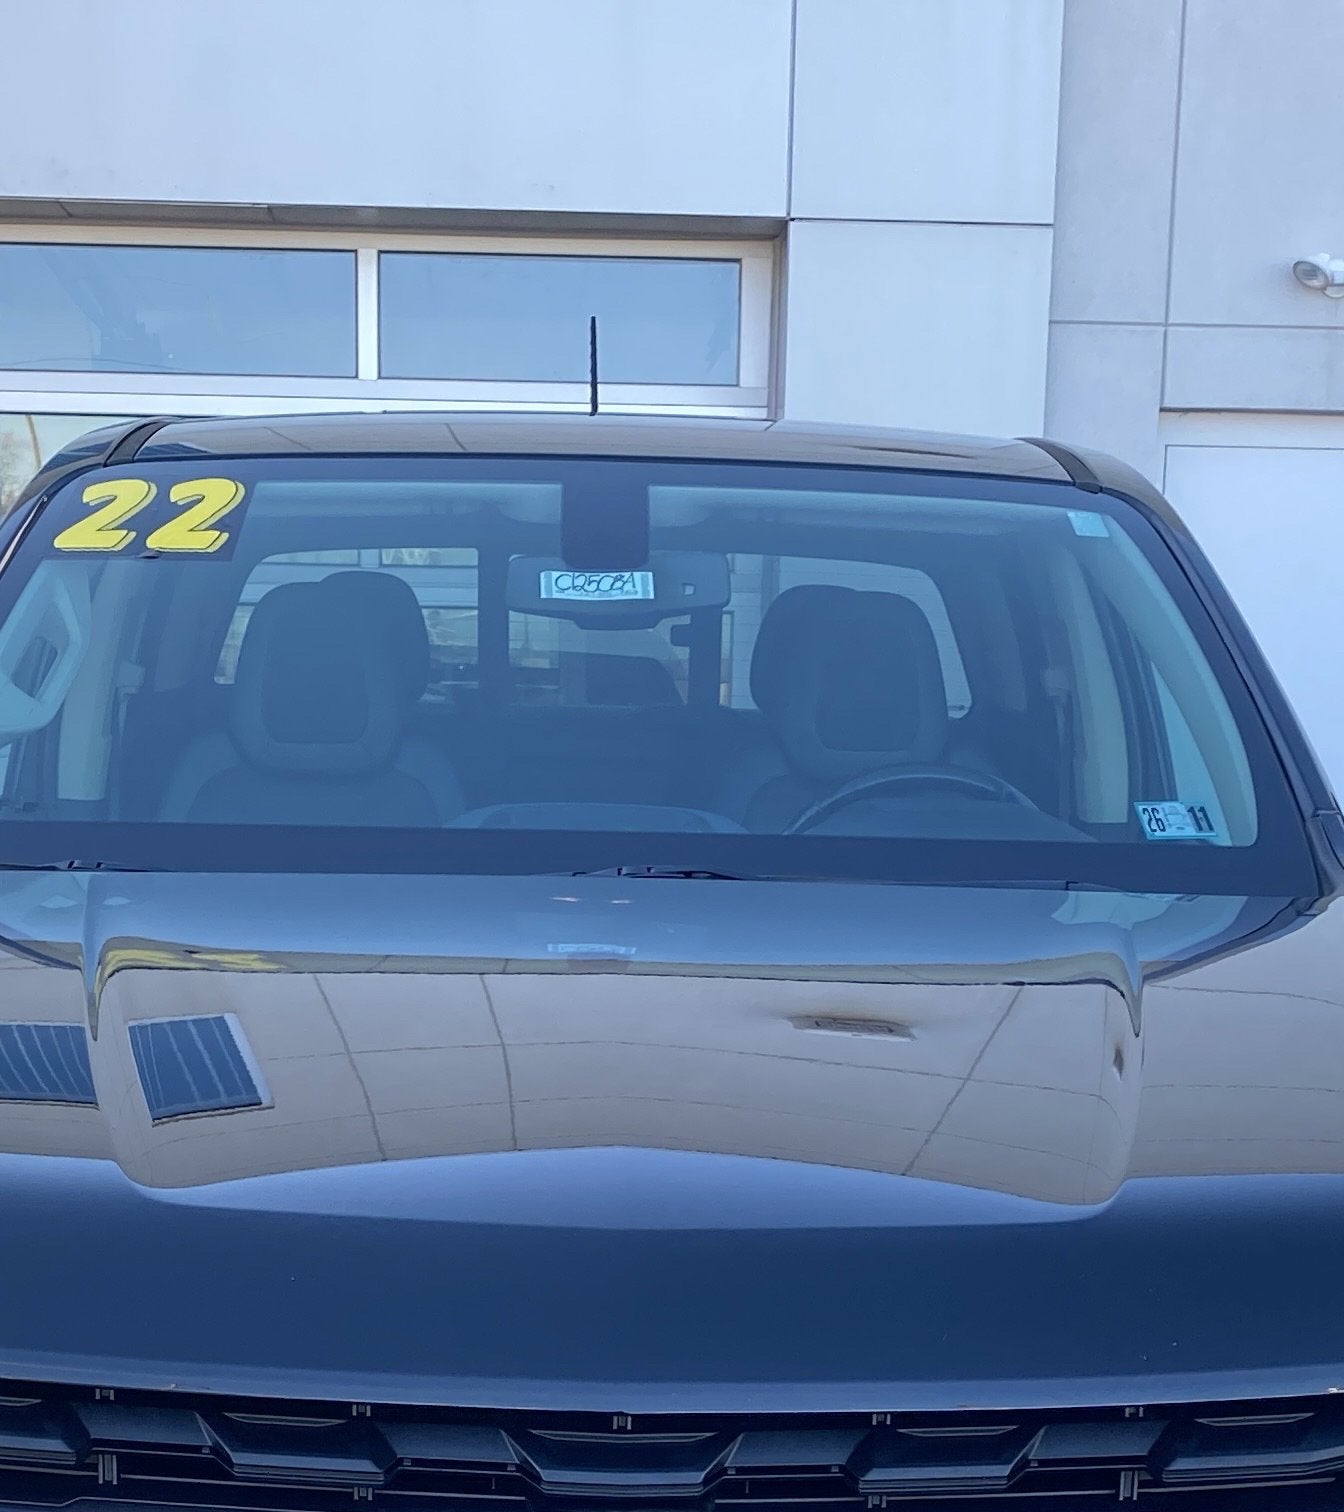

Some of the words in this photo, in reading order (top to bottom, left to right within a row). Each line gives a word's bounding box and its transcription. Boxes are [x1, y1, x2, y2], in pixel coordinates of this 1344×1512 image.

[53, 478, 246, 552] 22
[1142, 807, 1166, 832] 26
[1187, 806, 1214, 831] 11
